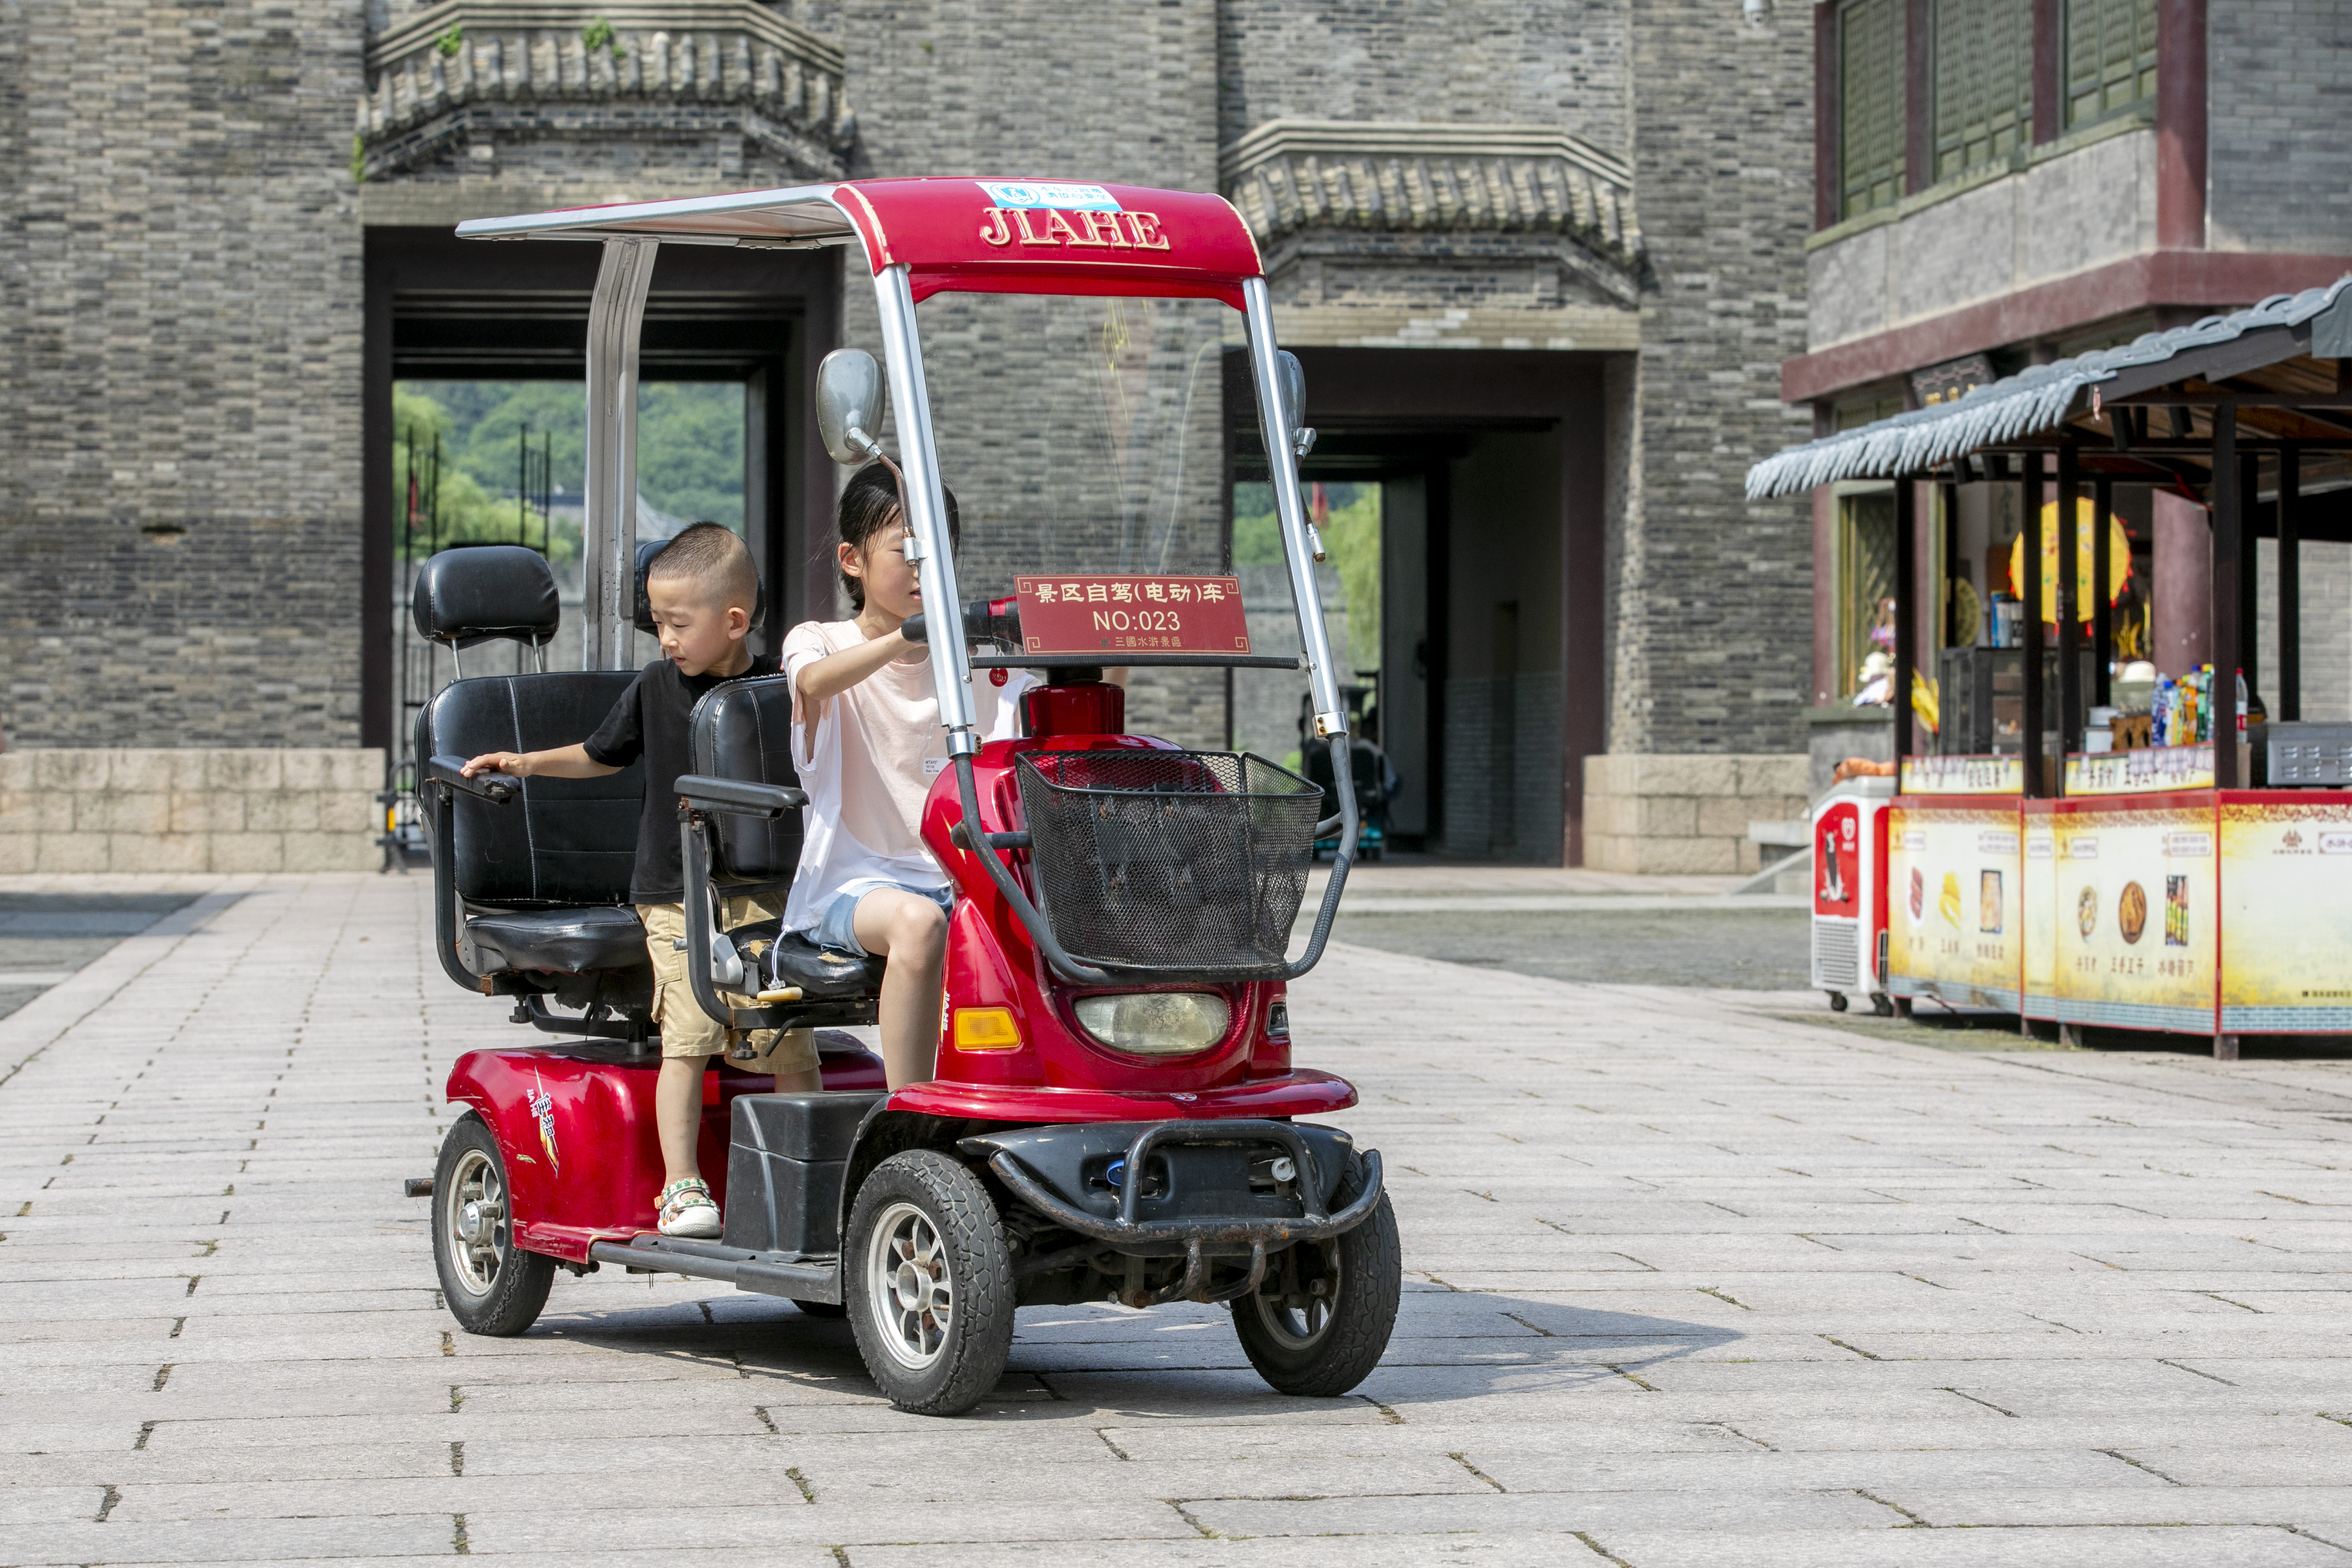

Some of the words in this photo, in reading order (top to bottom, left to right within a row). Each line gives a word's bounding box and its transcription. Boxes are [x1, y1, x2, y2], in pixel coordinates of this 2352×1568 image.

[980, 207, 1171, 251] JIAHE
[1035, 581, 1225, 604] 景区自驾(电动)车
[1093, 611, 1181, 631] NO:023
[1115, 636, 1182, 647] 三國水滸景區
[535, 1092, 555, 1137] 佳和
